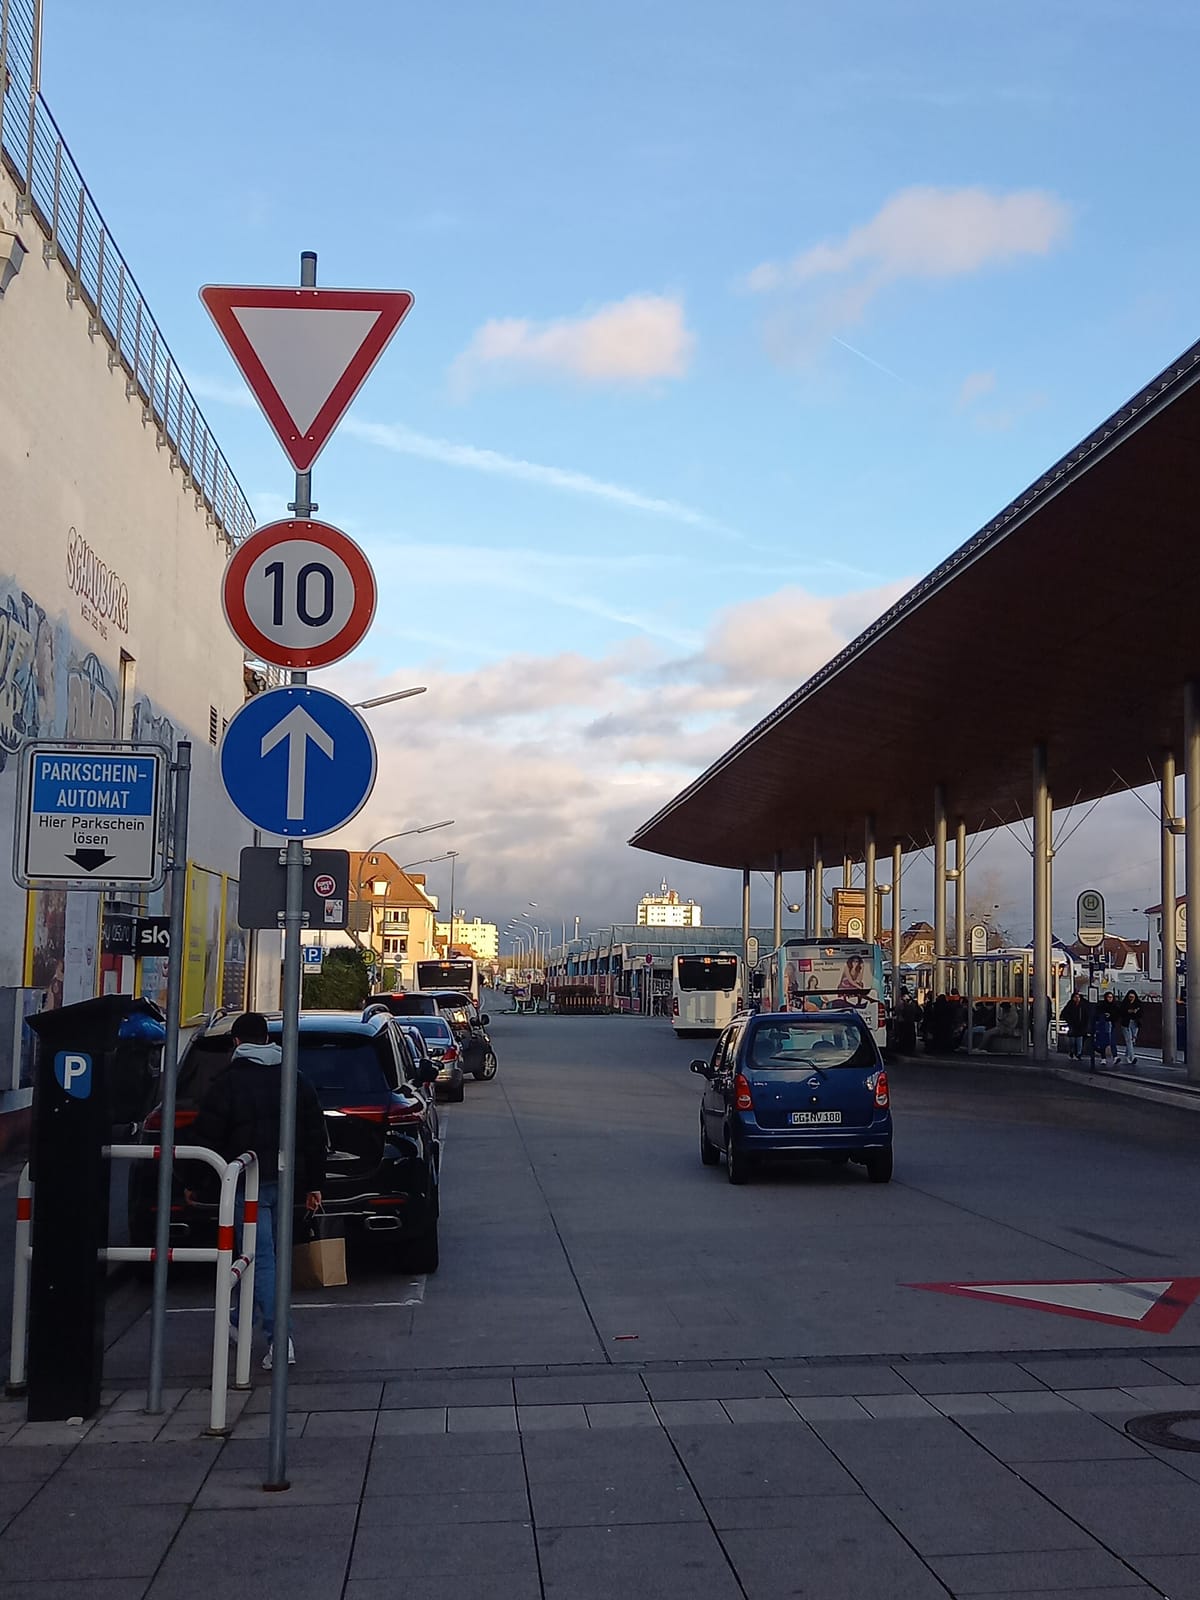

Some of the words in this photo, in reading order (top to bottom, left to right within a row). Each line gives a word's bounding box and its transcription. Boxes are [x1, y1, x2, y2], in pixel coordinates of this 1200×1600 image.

[264, 561, 334, 628] 10
[41, 762, 148, 783] PARKSCHEIN-
[56, 789, 130, 809] AUTOMAT
[39, 816, 66, 828] Hier
[71, 816, 145, 831] Parkschein
[73, 832, 109, 845] lösen
[141, 925, 170, 948] sky
[308, 949, 318, 962] P
[64, 1055, 87, 1090] P
